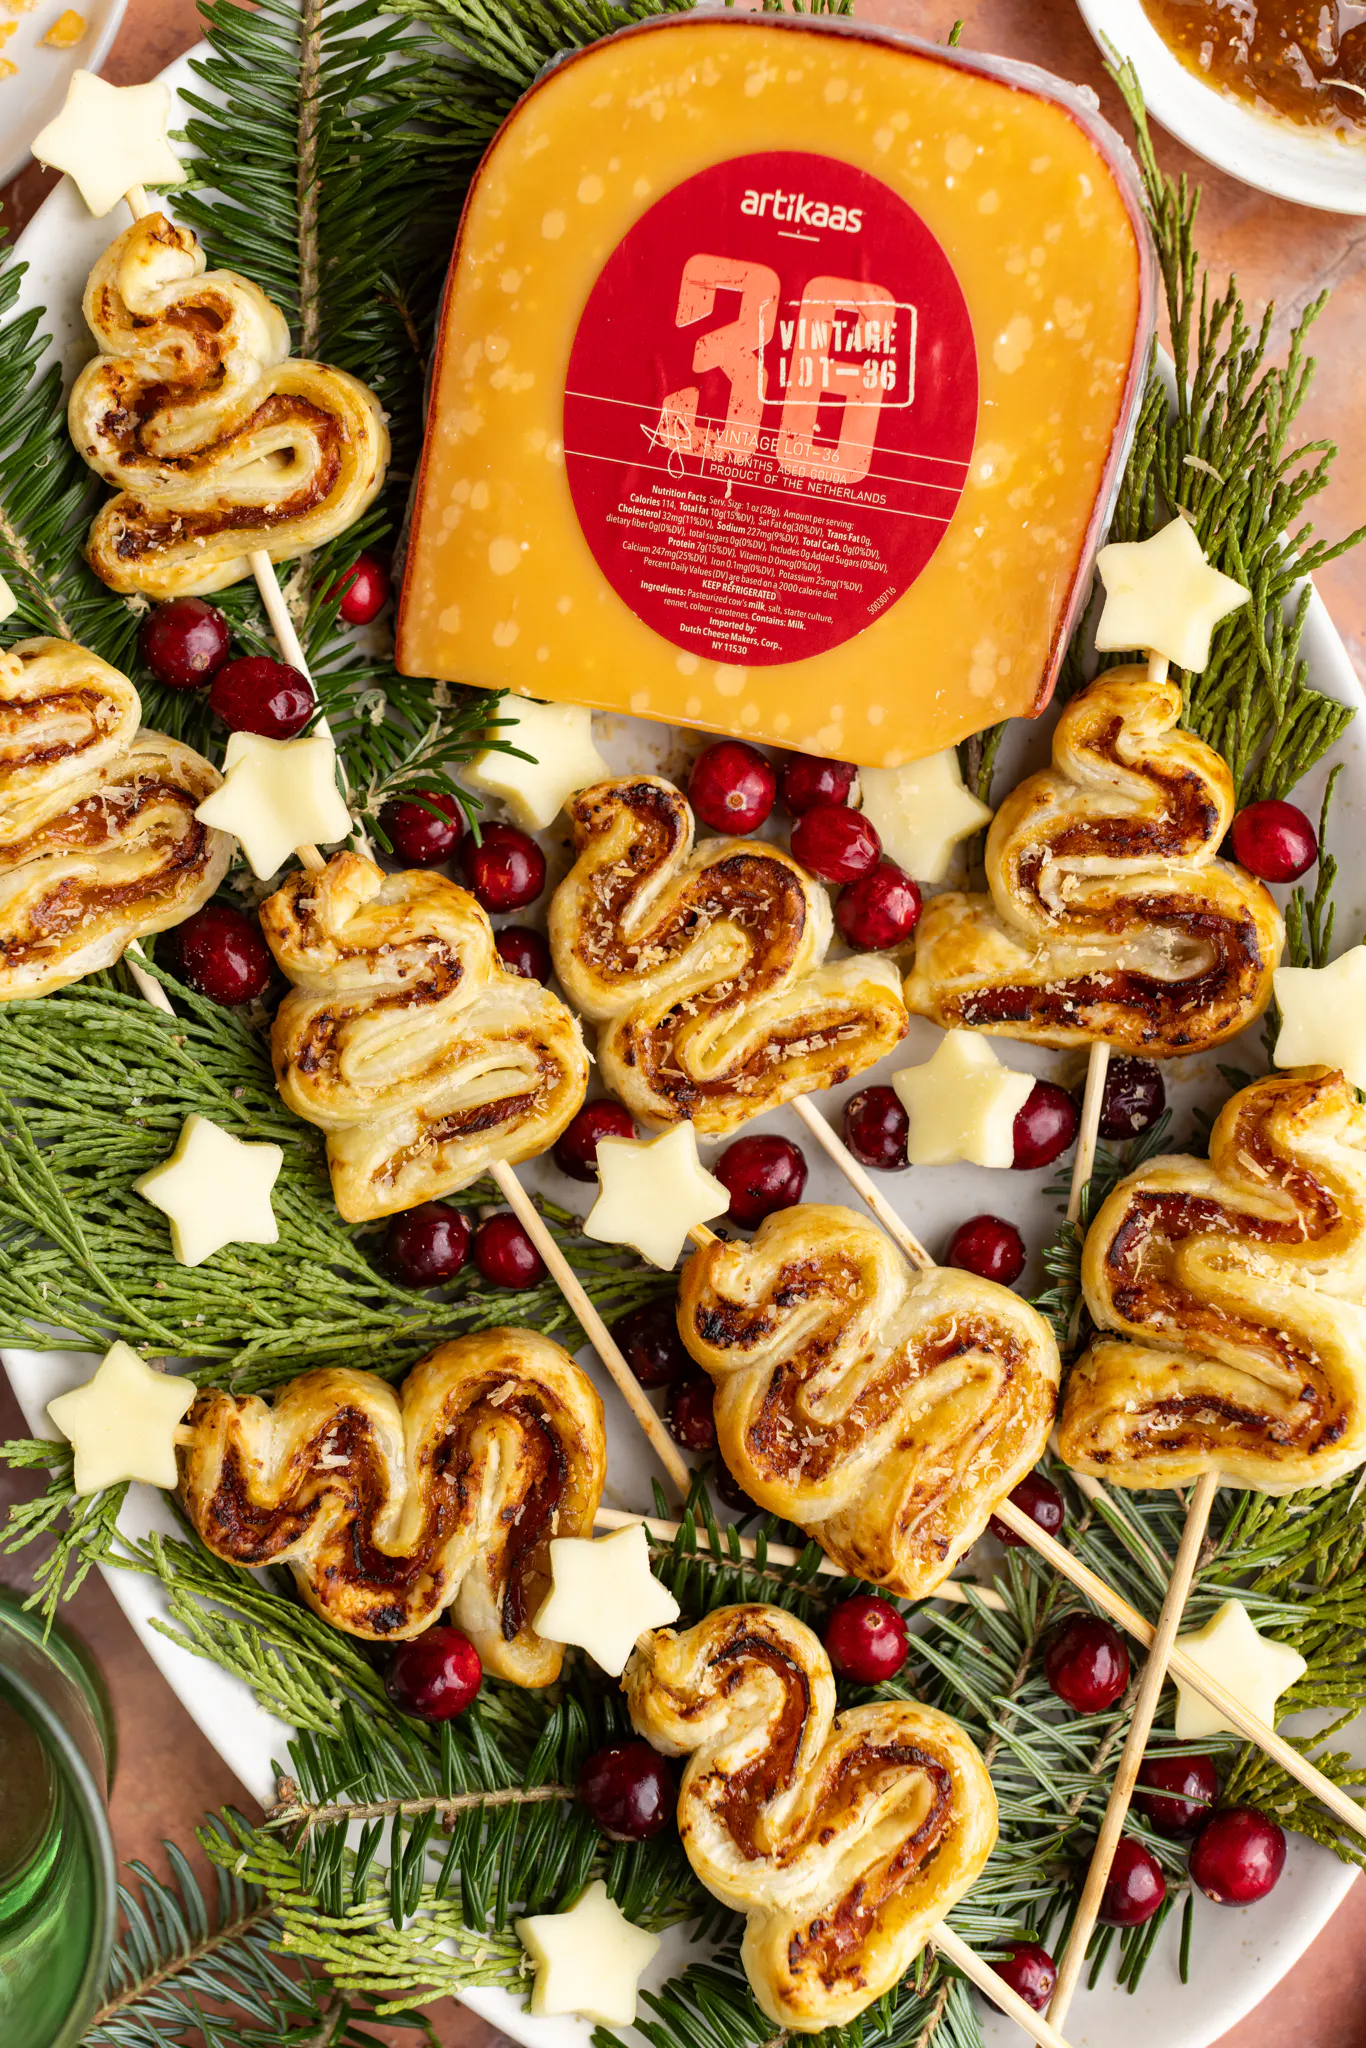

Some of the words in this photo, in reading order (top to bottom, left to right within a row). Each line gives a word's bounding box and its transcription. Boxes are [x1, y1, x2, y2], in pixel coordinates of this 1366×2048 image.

[740, 189, 863, 233] artikaas
[779, 320, 898, 354] VINTAGE
[659, 253, 897, 483] 36
[716, 428, 779, 453] VINTAGE
[784, 440, 840, 464] LOT-36
[709, 463, 760, 482] PRODUCT
[763, 474, 779, 486] OF
[781, 476, 803, 491] THE
[807, 481, 887, 505] NETHERLANDS
[727, 454, 773, 473] MONTHS
[777, 464, 805, 479] AGED
[810, 469, 847, 486] GOUDA
[617, 502, 661, 519] Cholesterol
[716, 520, 746, 534] Sodium
[802, 536, 821, 548] Total
[821, 539, 841, 552] Carb.
[629, 492, 660, 506] Calories
[661, 498, 676, 510] 114,
[679, 501, 698, 513] Total
[698, 504, 709, 515] fat
[757, 516, 770, 526] Sat
[769, 518, 781, 529] Fat
[827, 528, 847, 540] Trans
[847, 532, 860, 543] Fat
[860, 534, 872, 547] 0g,
[651, 484, 686, 499] Nutrition
[686, 490, 706, 502] Facts
[708, 495, 726, 506] Serv.
[727, 498, 743, 511] Size:
[745, 501, 749, 510] 1
[750, 504, 759, 512] oz
[783, 508, 812, 522] Amount
[812, 515, 825, 524] per
[825, 518, 854, 531] serving:
[605, 512, 631, 527] dietary
[631, 517, 648, 528] fiber
[688, 528, 705, 538] total
[705, 532, 729, 543] sugars
[769, 543, 799, 556] Includes
[799, 548, 810, 560] 0g
[810, 550, 834, 562] Added
[834, 554, 859, 567] Sugars
[667, 536, 695, 549] Protein
[739, 549, 766, 562] Vitamin
[767, 554, 774, 563] D
[621, 540, 650, 553] Calcium
[710, 556, 725, 567] Iron
[778, 568, 814, 583] Potassium
[643, 555, 670, 569] Percent
[670, 561, 688, 574] Daily
[688, 564, 712, 576] Values
[728, 573, 740, 583] are
[740, 573, 762, 586] based
[762, 580, 772, 588] on
[772, 581, 777, 589] a
[777, 581, 798, 592] 2000
[797, 585, 822, 597] calorie
[822, 589, 838, 600] diet.
[639, 579, 686, 596] Ingredients:
[686, 588, 728, 603] Pasteurized
[727, 597, 747, 607] cow's
[747, 600, 766, 612] milk,
[767, 604, 782, 615] salt,
[783, 607, 807, 618] starter
[807, 611, 833, 624] culture,
[701, 578, 721, 590] KEEP
[721, 582, 776, 600] REFRIGERATED
[866, 586, 897, 615] 50030716
[663, 598, 688, 609] rennet,
[689, 601, 713, 612] colour:
[714, 607, 749, 620] carotenes.
[750, 612, 786, 626] Contains:
[786, 618, 806, 630] Milk.
[708, 616, 744, 630] Imported
[744, 622, 757, 634] by:
[679, 622, 701, 634] Dutch
[701, 626, 729, 640] Cheese
[729, 631, 759, 646] Makers,
[760, 637, 782, 650] Corp.,
[711, 640, 723, 650] NY
[723, 642, 747, 654] 11530
